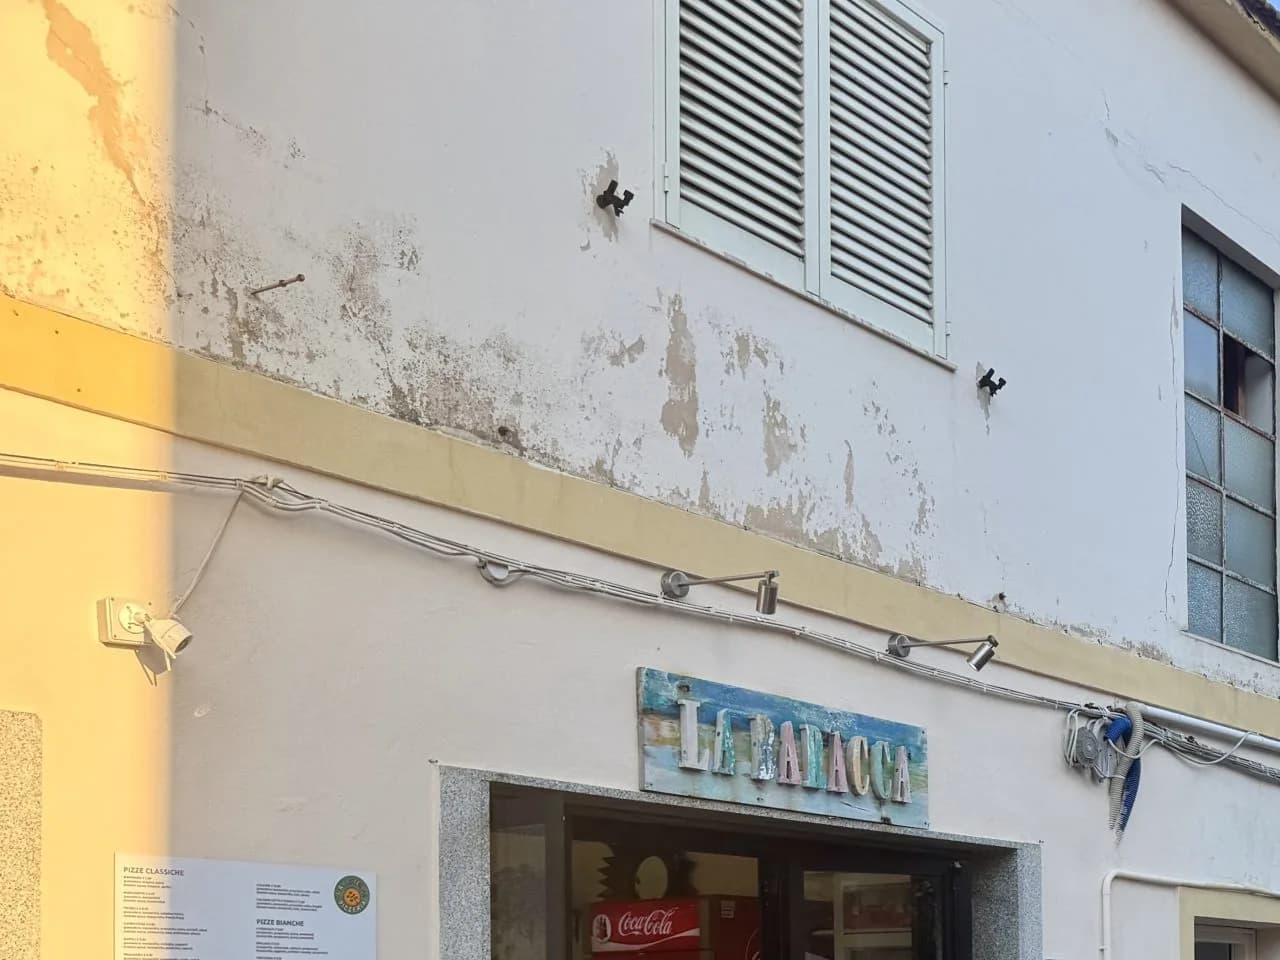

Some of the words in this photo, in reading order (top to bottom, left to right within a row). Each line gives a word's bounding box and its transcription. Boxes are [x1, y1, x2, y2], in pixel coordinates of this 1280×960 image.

[678, 699, 736, 776] LA
[750, 713, 912, 803] BARACCA
[146, 868, 185, 876] CLASSICHE
[276, 919, 304, 927] BIANCHE
